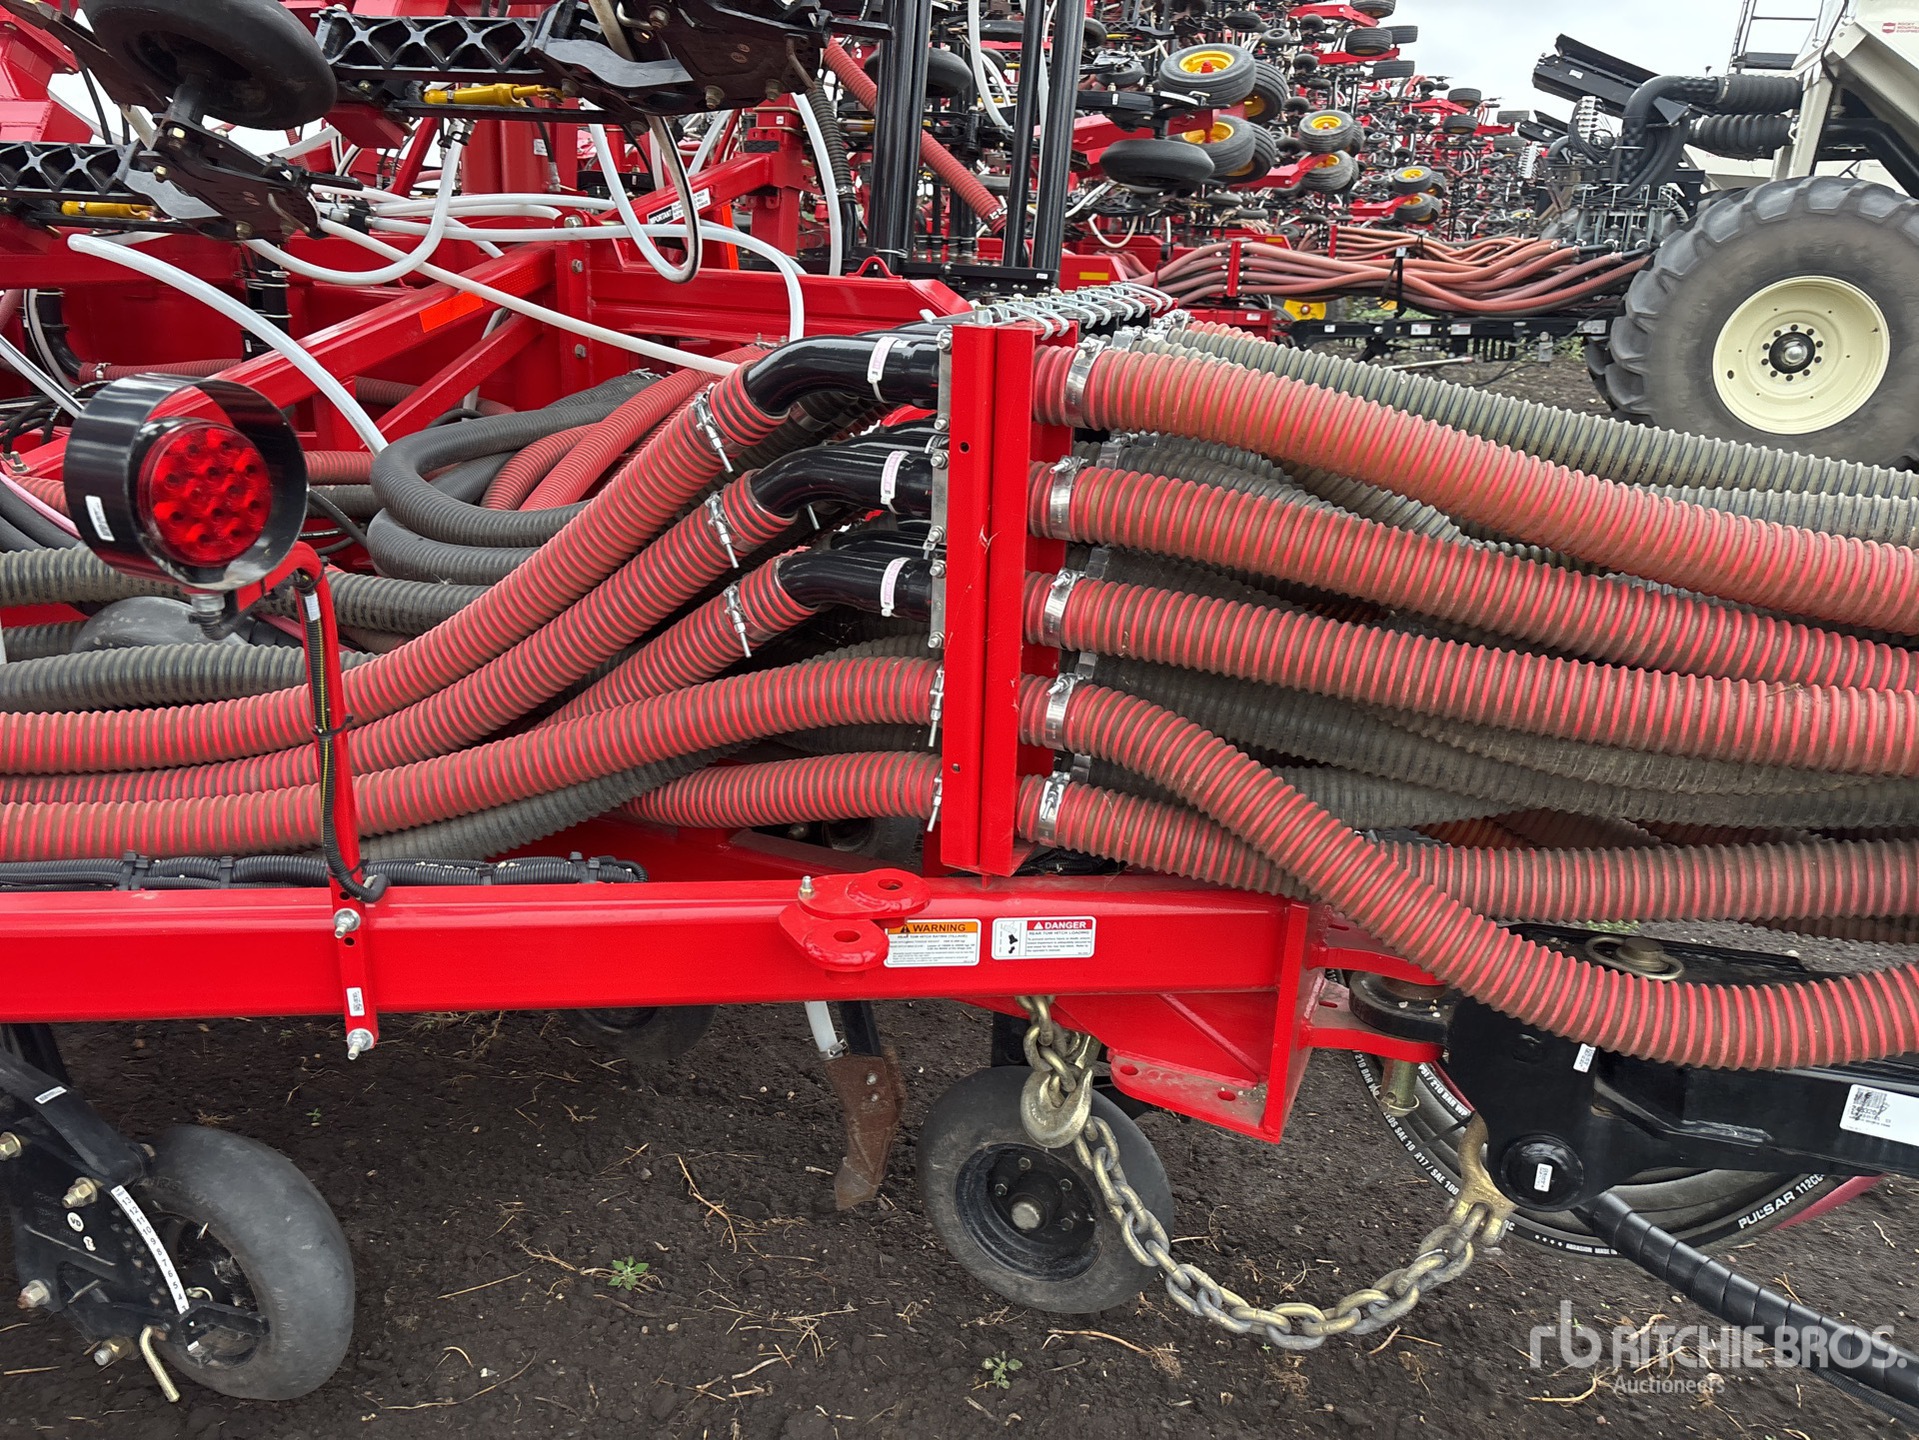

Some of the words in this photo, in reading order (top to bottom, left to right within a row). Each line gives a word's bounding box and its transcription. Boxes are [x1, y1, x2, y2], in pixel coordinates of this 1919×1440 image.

[912, 923, 966, 932] WARNING
[1044, 921, 1087, 929] DANGER
[1361, 1068, 1374, 1086] BAR
[1430, 1079, 1444, 1095] 210
[1441, 1091, 1457, 1107] BAR
[1455, 1103, 1468, 1116] WP
[1394, 1125, 1408, 1141] SAE
[1430, 1168, 1445, 1184] SAE
[122, 1196, 132, 1206] 13
[129, 1205, 139, 1216] 12
[136, 1216, 146, 1225] 11
[142, 1225, 152, 1236] 10
[1738, 1190, 1796, 1229] PULSAR
